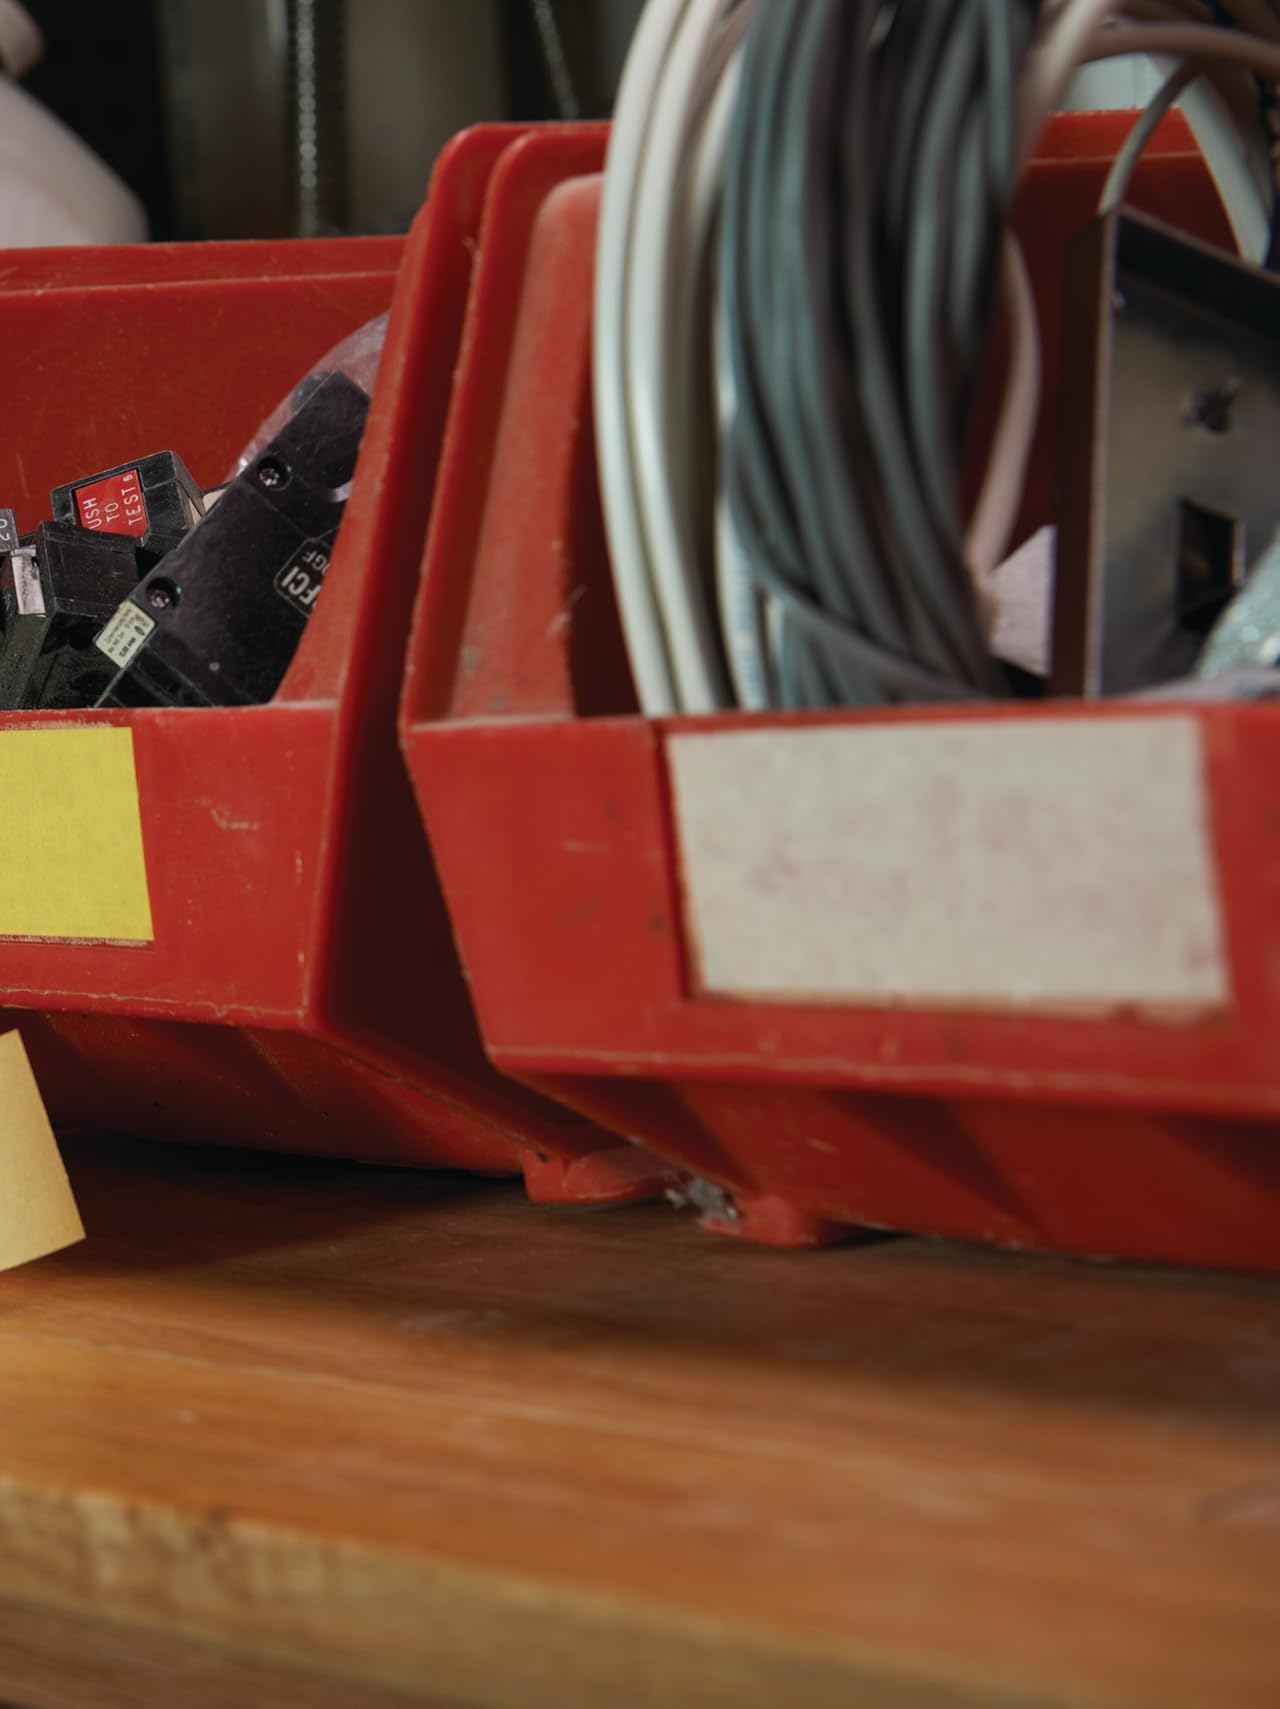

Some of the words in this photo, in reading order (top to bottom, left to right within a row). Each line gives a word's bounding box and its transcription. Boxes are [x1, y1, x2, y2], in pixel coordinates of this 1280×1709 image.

[82, 497, 102, 530] USH
[104, 502, 120, 523] TO
[121, 486, 143, 526] TEST
[281, 566, 322, 608] FCI
